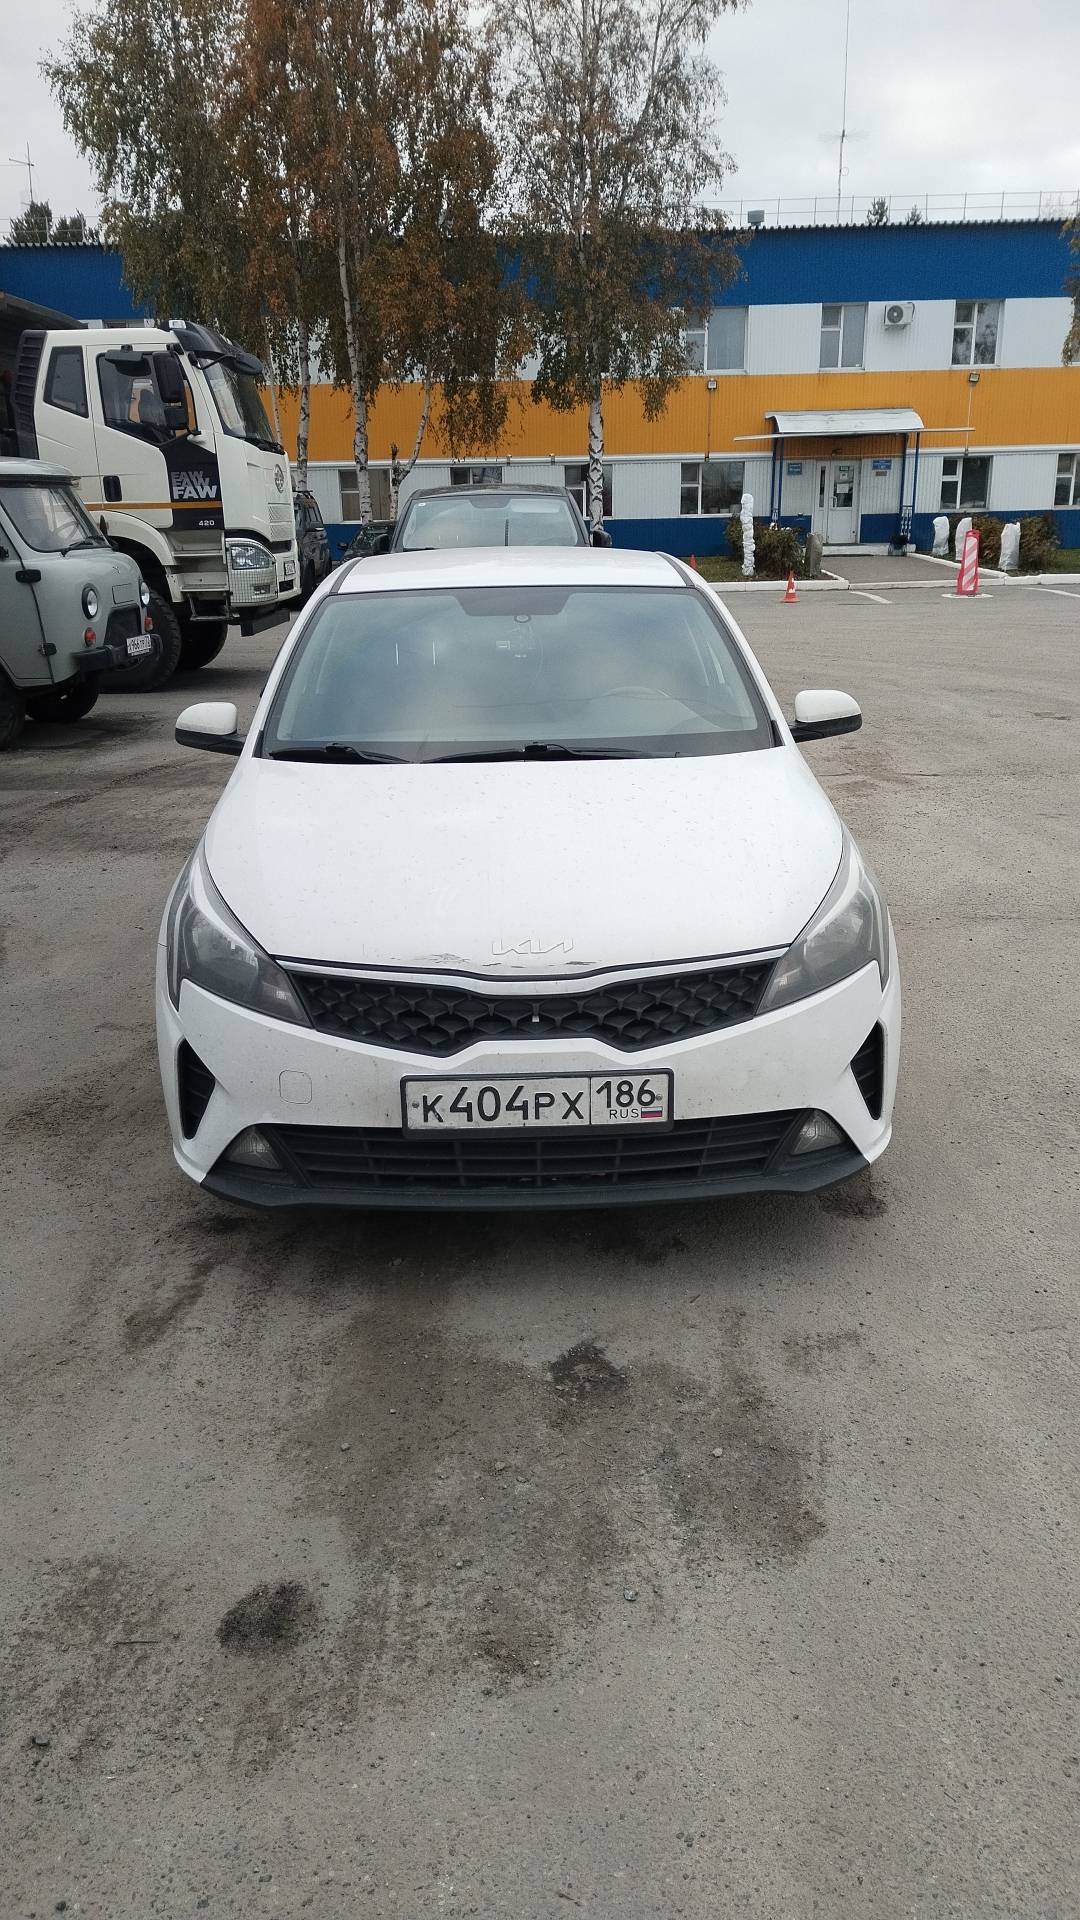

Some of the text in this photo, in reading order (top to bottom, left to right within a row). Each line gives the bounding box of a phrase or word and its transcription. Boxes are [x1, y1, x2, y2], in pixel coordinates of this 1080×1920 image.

[173, 485, 217, 499] FAW
[422, 1079, 657, 1123] К404РХ 186
[609, 1109, 639, 1120] RUS
